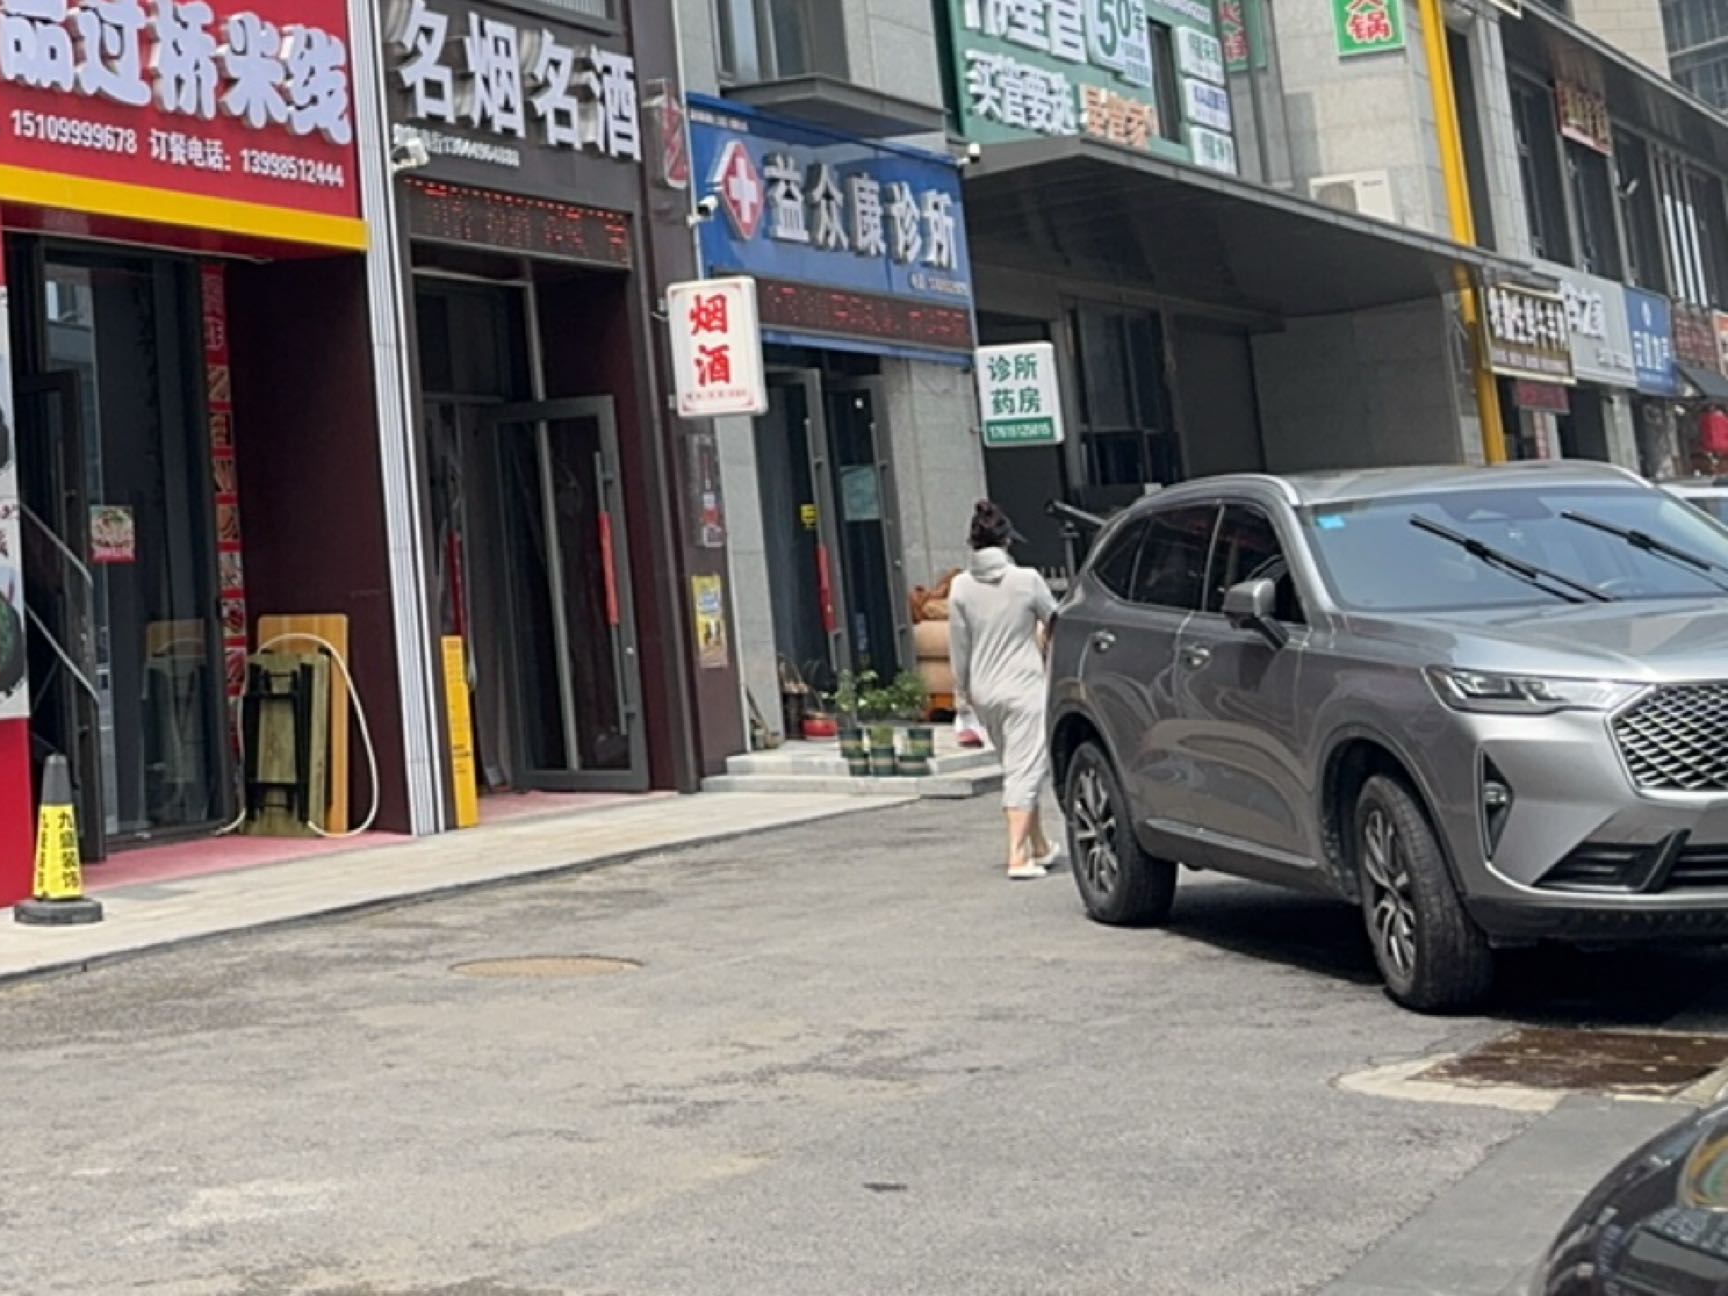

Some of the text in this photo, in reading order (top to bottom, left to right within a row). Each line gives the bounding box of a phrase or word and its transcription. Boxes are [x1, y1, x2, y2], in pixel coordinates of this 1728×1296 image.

[10, 109, 137, 154] 15109999678
[240, 149, 345, 188] 13998512444
[763, 148, 959, 270] 益众康诊所
[689, 293, 731, 388] 烟酒
[986, 353, 1038, 382] 诊所
[991, 387, 1042, 415] 药房
